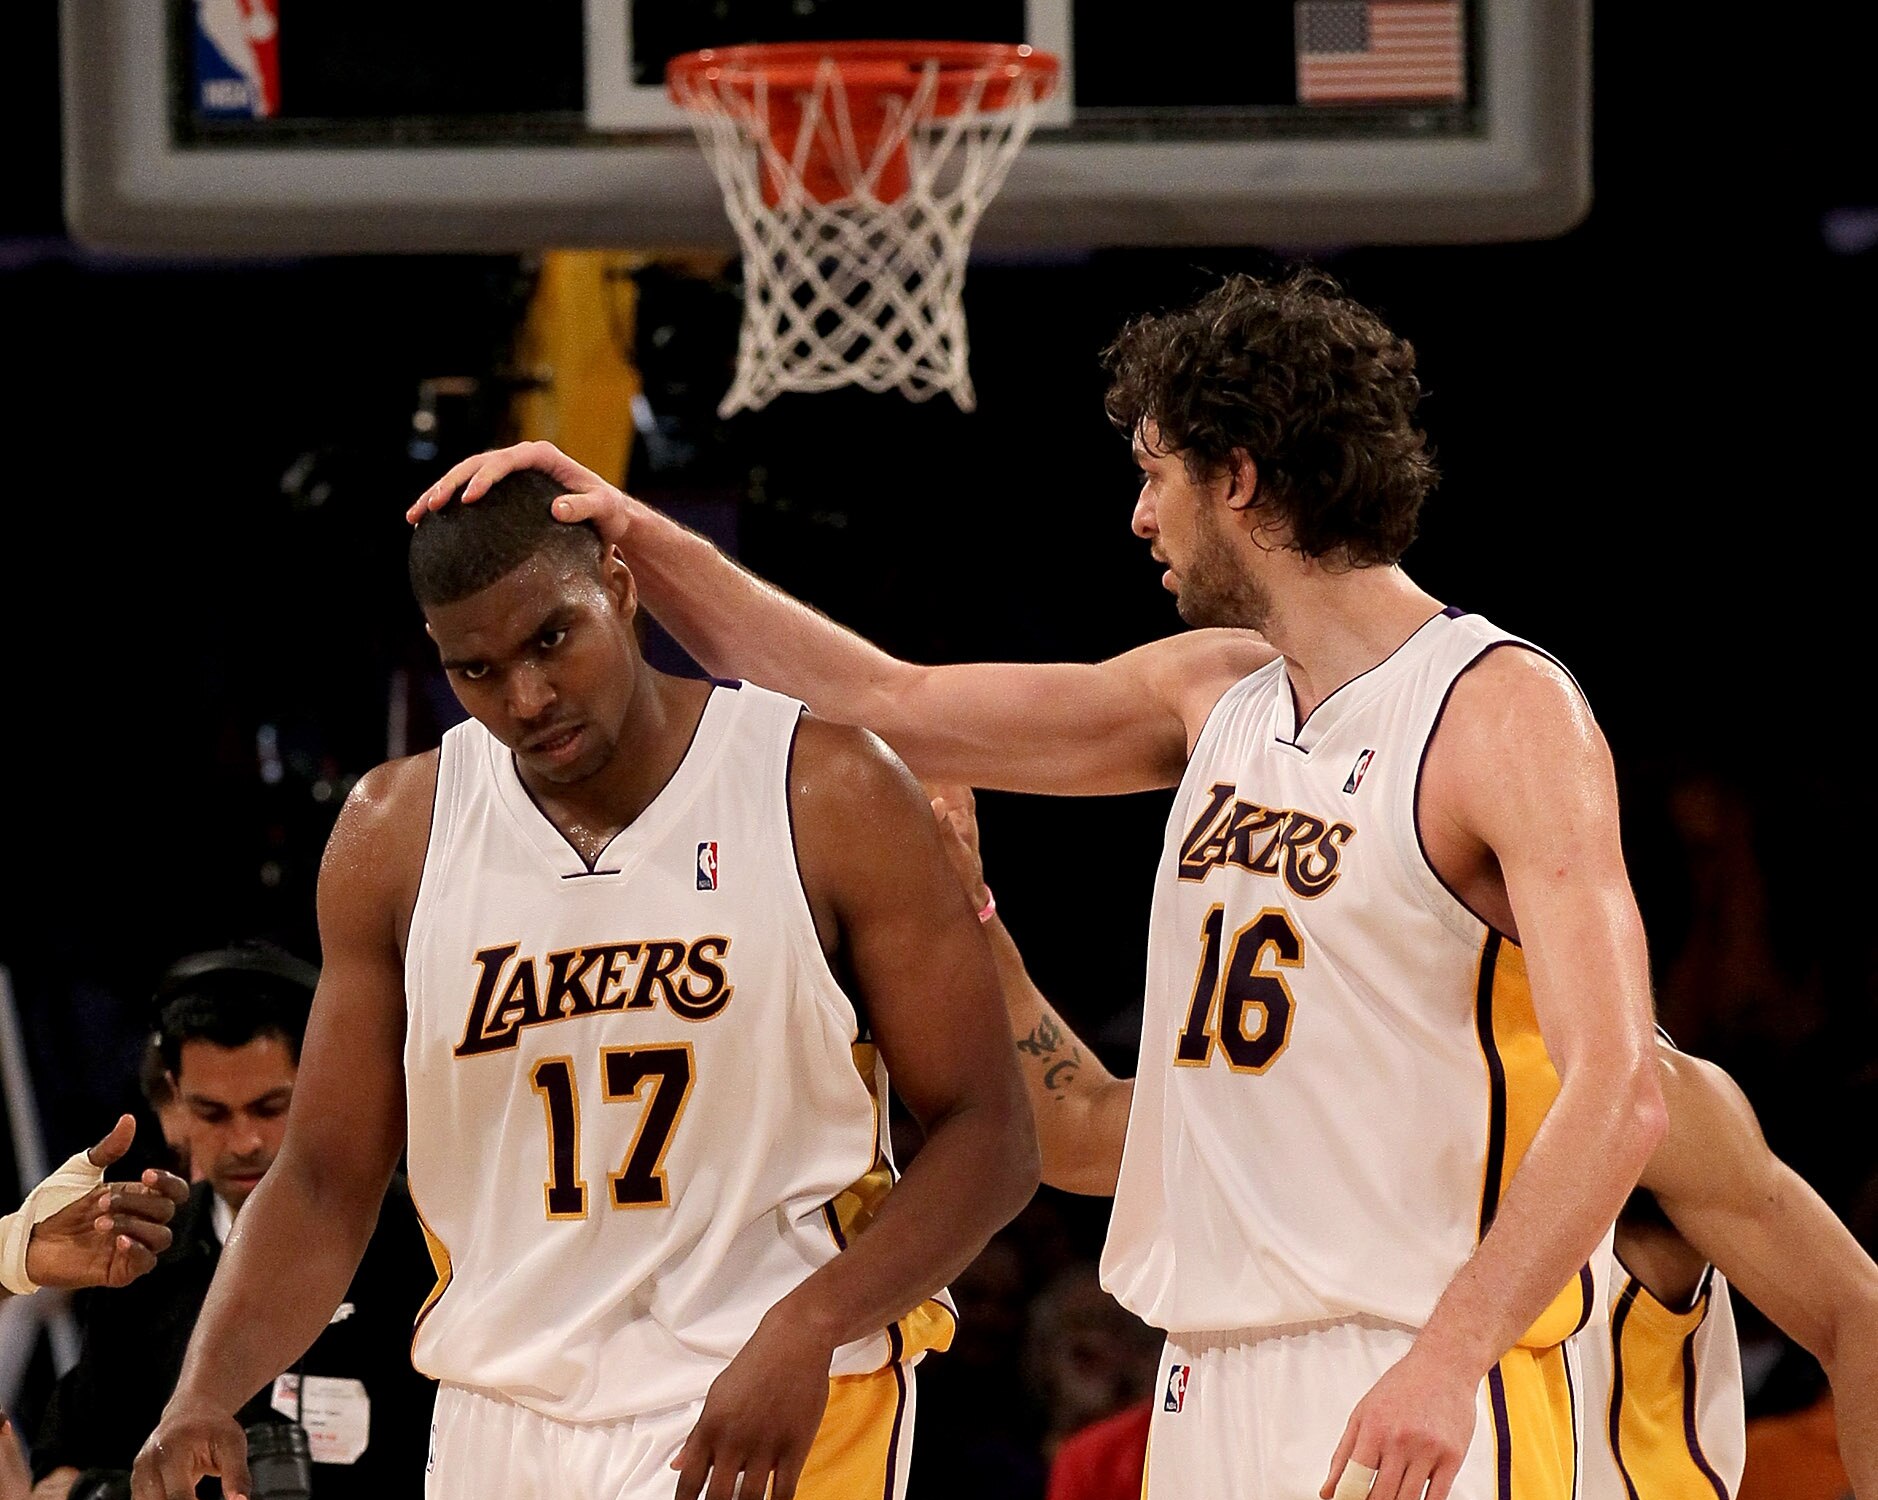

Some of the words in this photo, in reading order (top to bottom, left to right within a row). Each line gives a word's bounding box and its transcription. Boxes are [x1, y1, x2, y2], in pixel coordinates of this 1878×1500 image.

[453, 934, 734, 1061] LAKERS
[1173, 901, 1305, 1076] 16
[529, 1042, 697, 1221] 17
